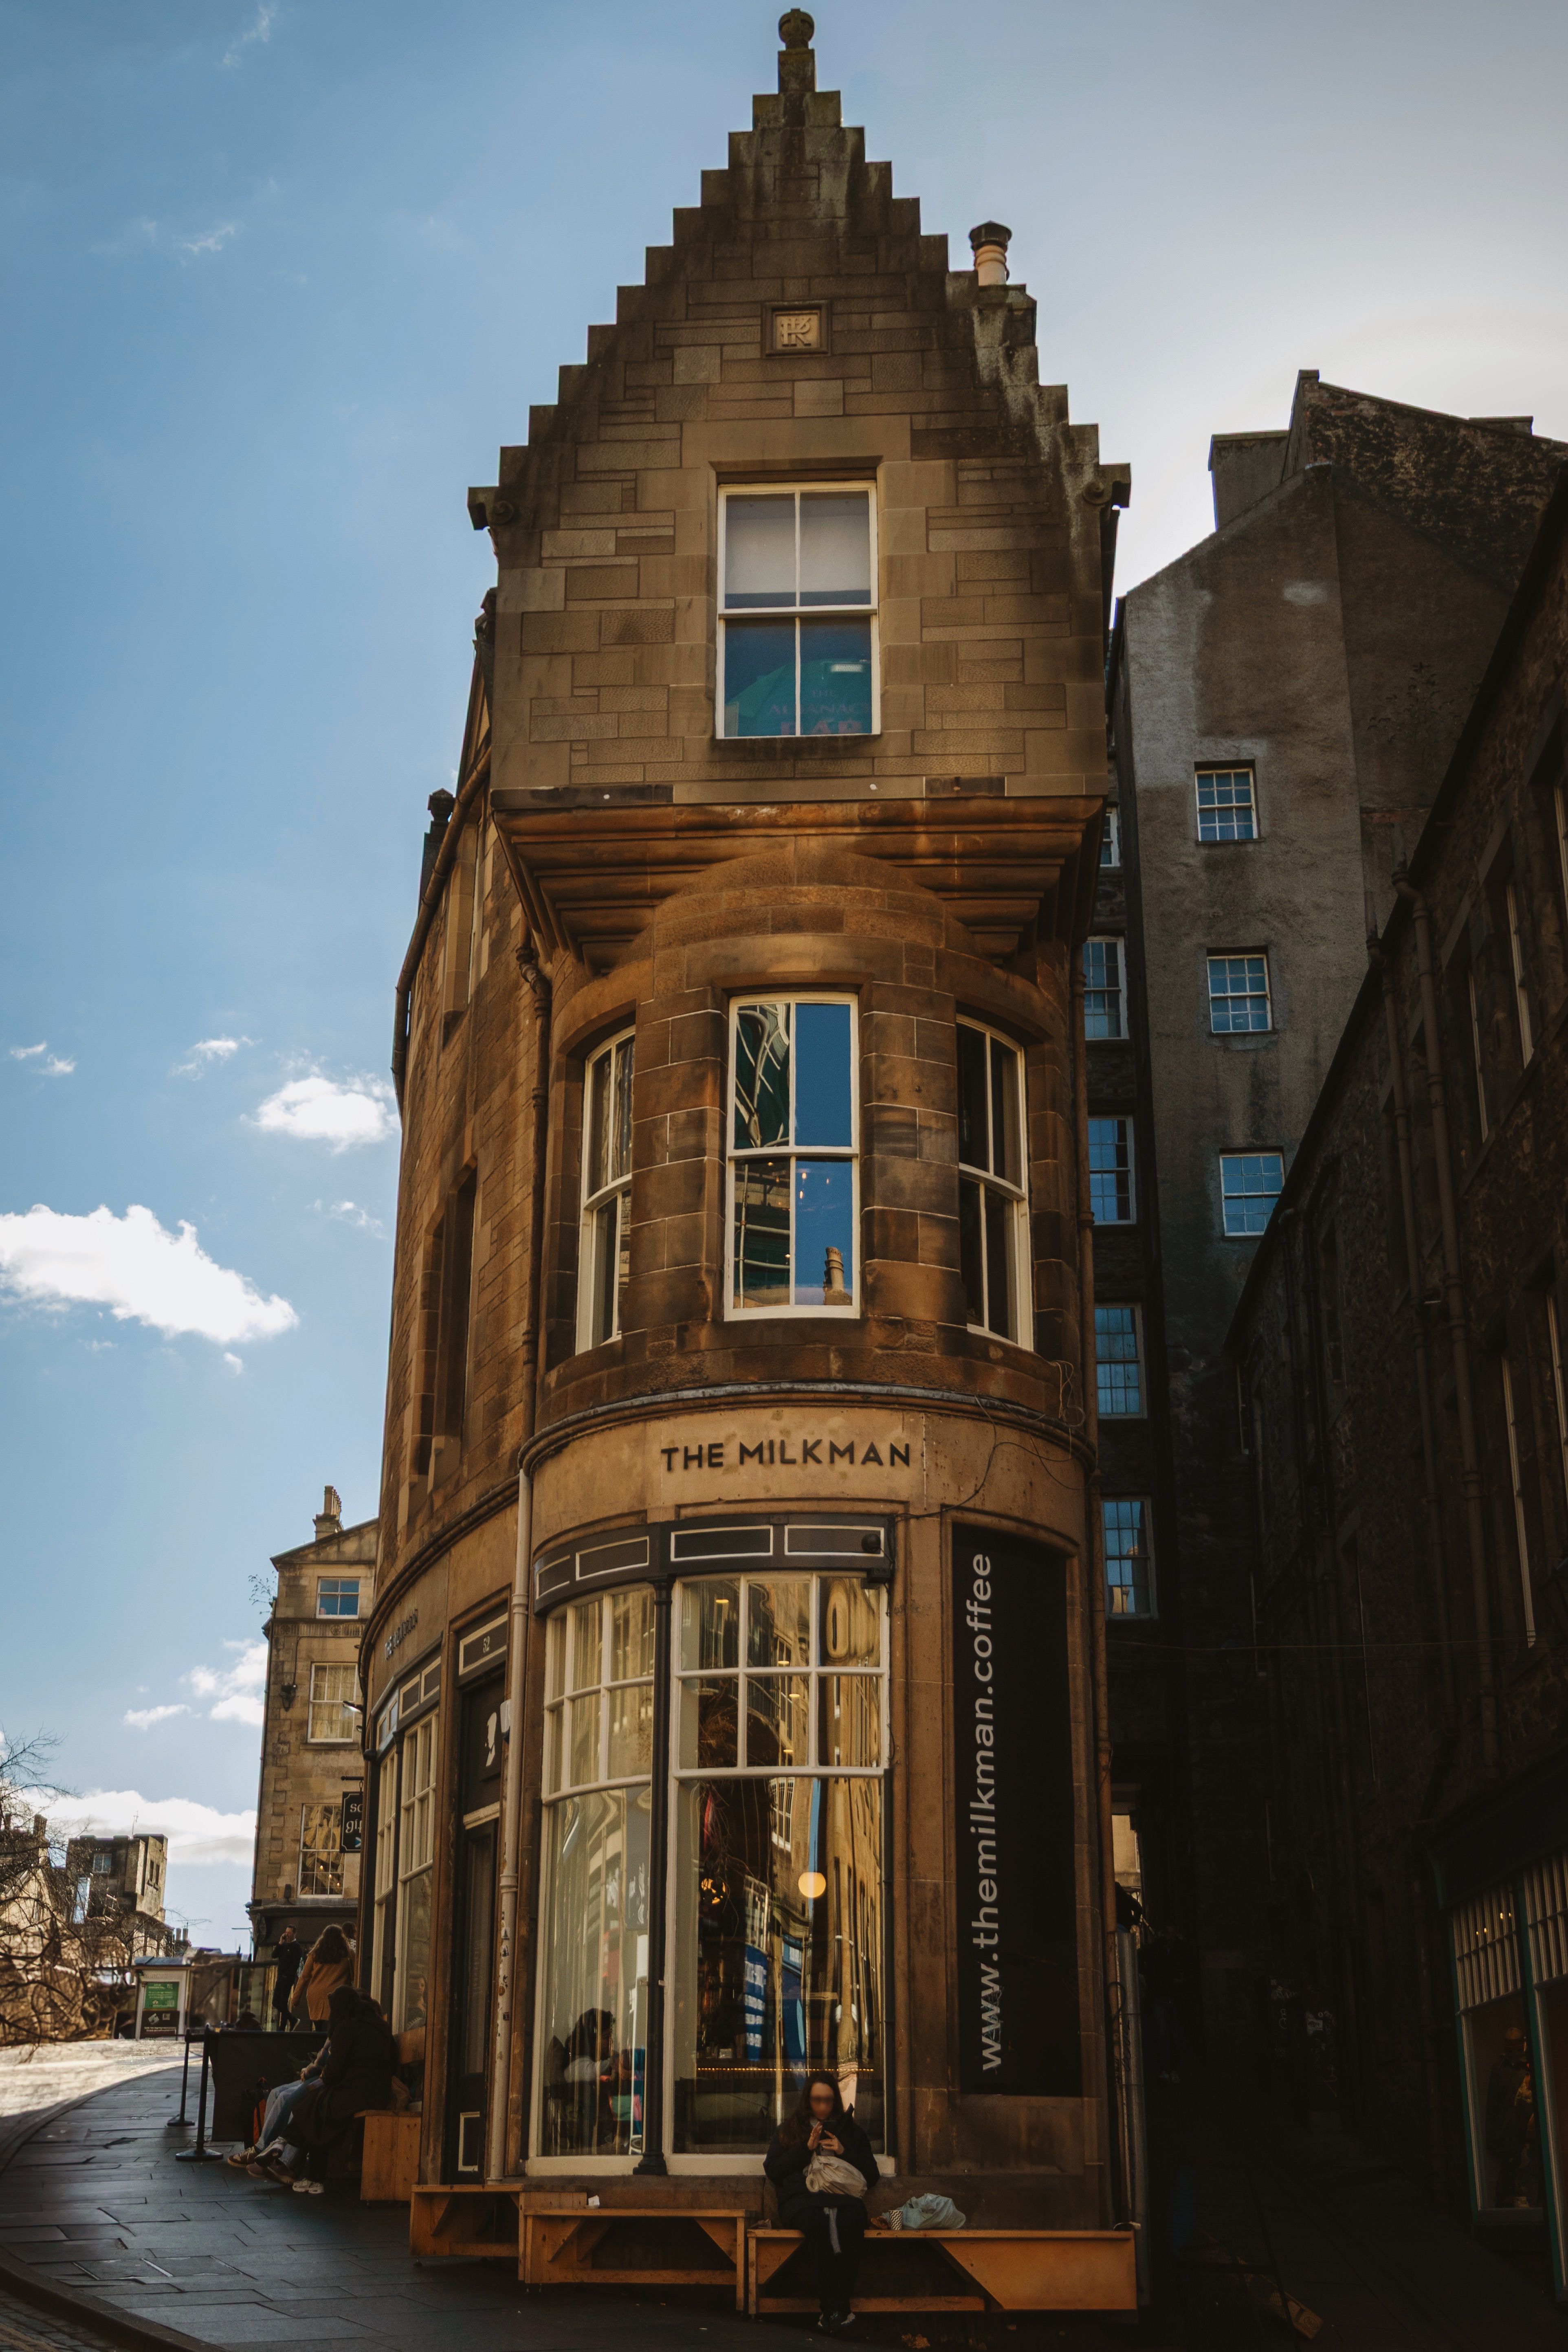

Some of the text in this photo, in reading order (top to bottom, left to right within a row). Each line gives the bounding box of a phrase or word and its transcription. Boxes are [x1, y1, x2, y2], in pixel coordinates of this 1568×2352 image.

[661, 1439, 909, 1471] THE MILKMAN
[483, 1636, 490, 1653] 52
[966, 1554, 1001, 2070] www.themilkman.coffee
